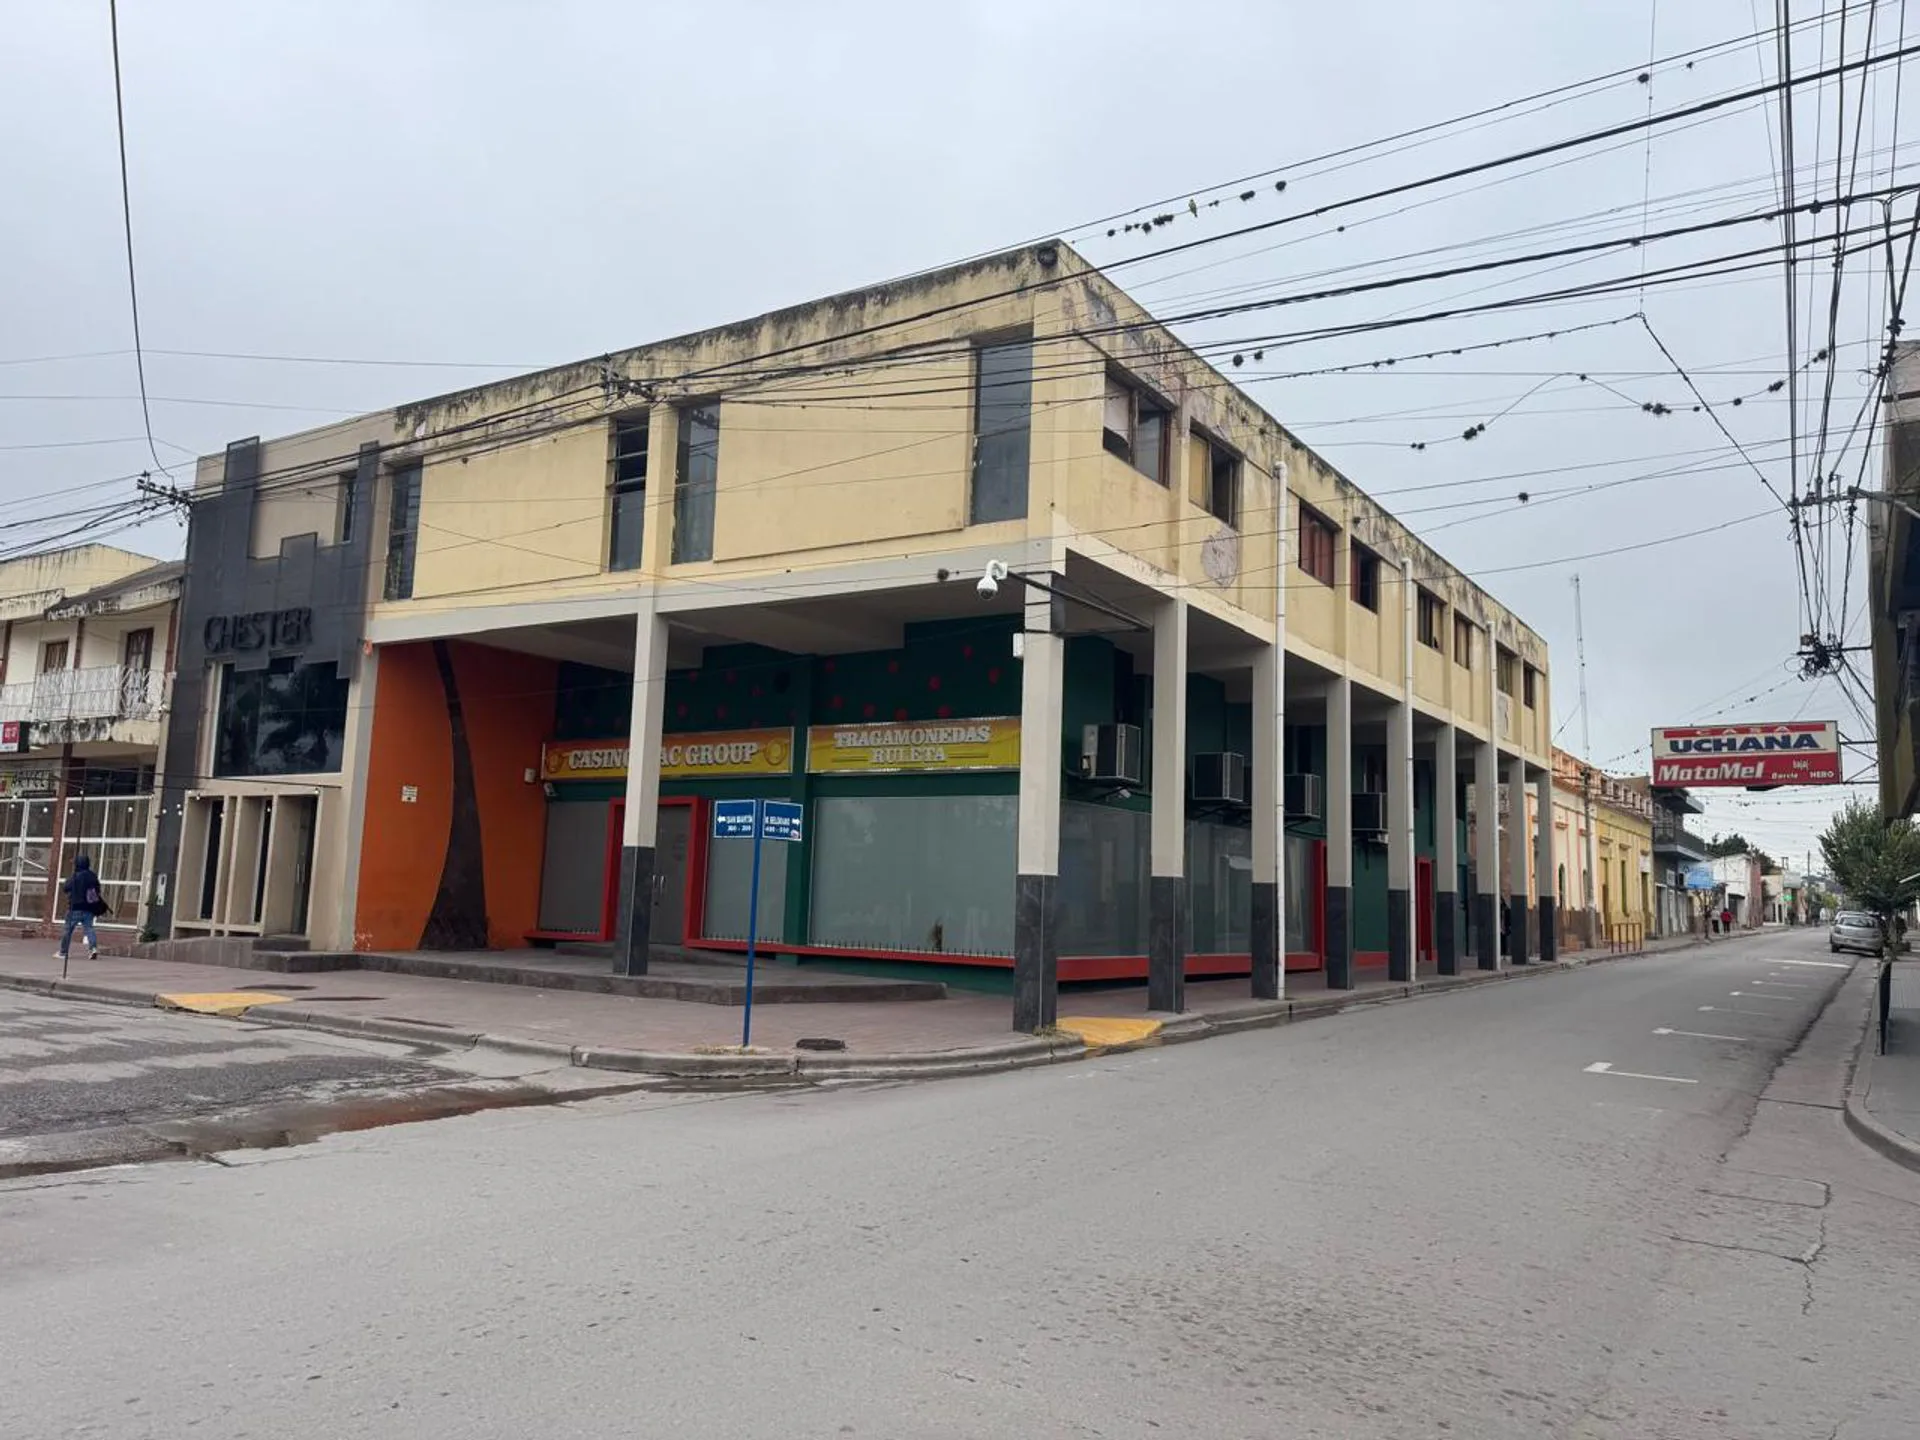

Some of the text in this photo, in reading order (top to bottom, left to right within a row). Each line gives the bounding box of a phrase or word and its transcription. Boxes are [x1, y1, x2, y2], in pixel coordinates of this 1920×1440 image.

[203, 607, 312, 652] CHESTER
[834, 726, 991, 747] TRAGAMONEDAS
[1669, 734, 1821, 753] UCHANA
[685, 743, 758, 766] GROUP
[871, 747, 946, 763] RULETA
[1658, 762, 1764, 780] MotoMel
